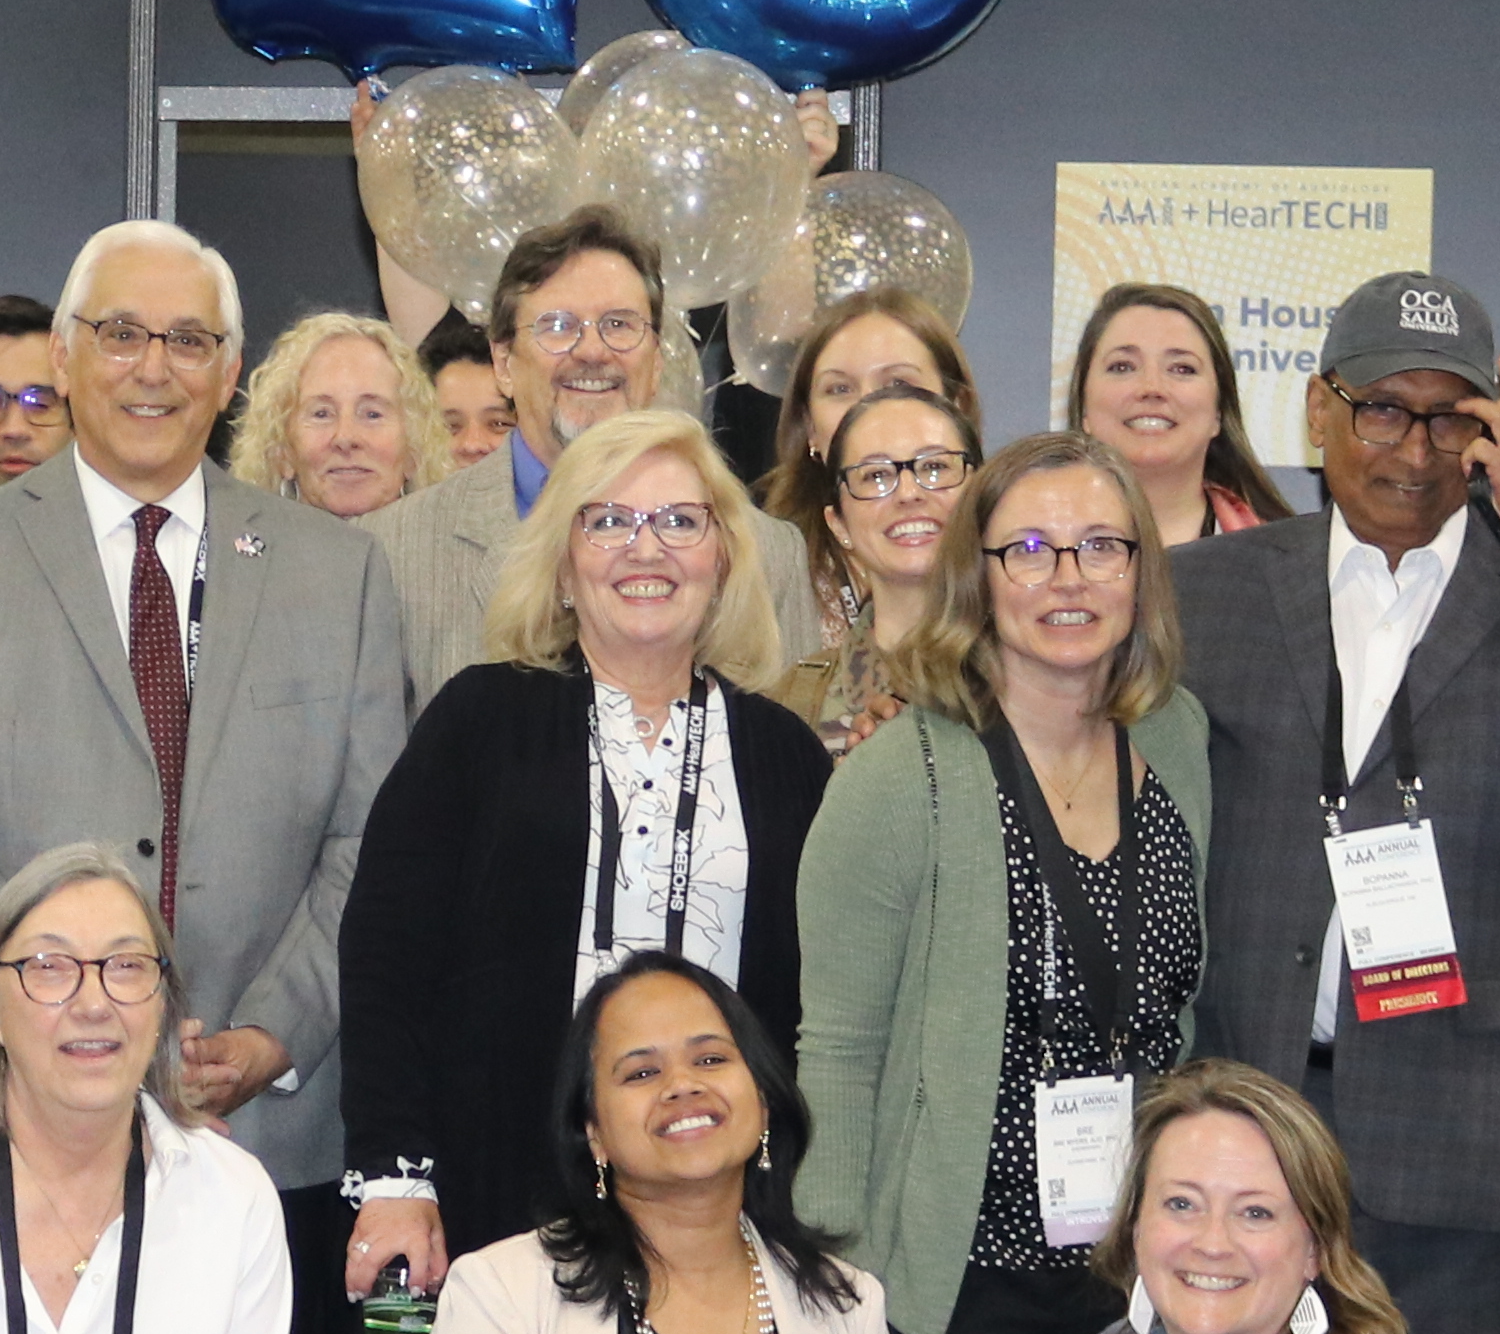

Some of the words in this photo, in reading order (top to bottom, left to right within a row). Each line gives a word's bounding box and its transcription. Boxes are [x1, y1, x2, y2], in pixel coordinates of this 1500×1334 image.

[1207, 199, 1371, 230] HearTECH
[1400, 289, 1458, 317] OCA
[1401, 311, 1459, 329] SALUS
[1377, 839, 1420, 855] ANNUAL
[670, 829, 690, 911] SHOEBOX
[1362, 971, 1390, 986] BOARD
[1391, 969, 1403, 981] OF
[1081, 1094, 1120, 1106] ANNUAL
